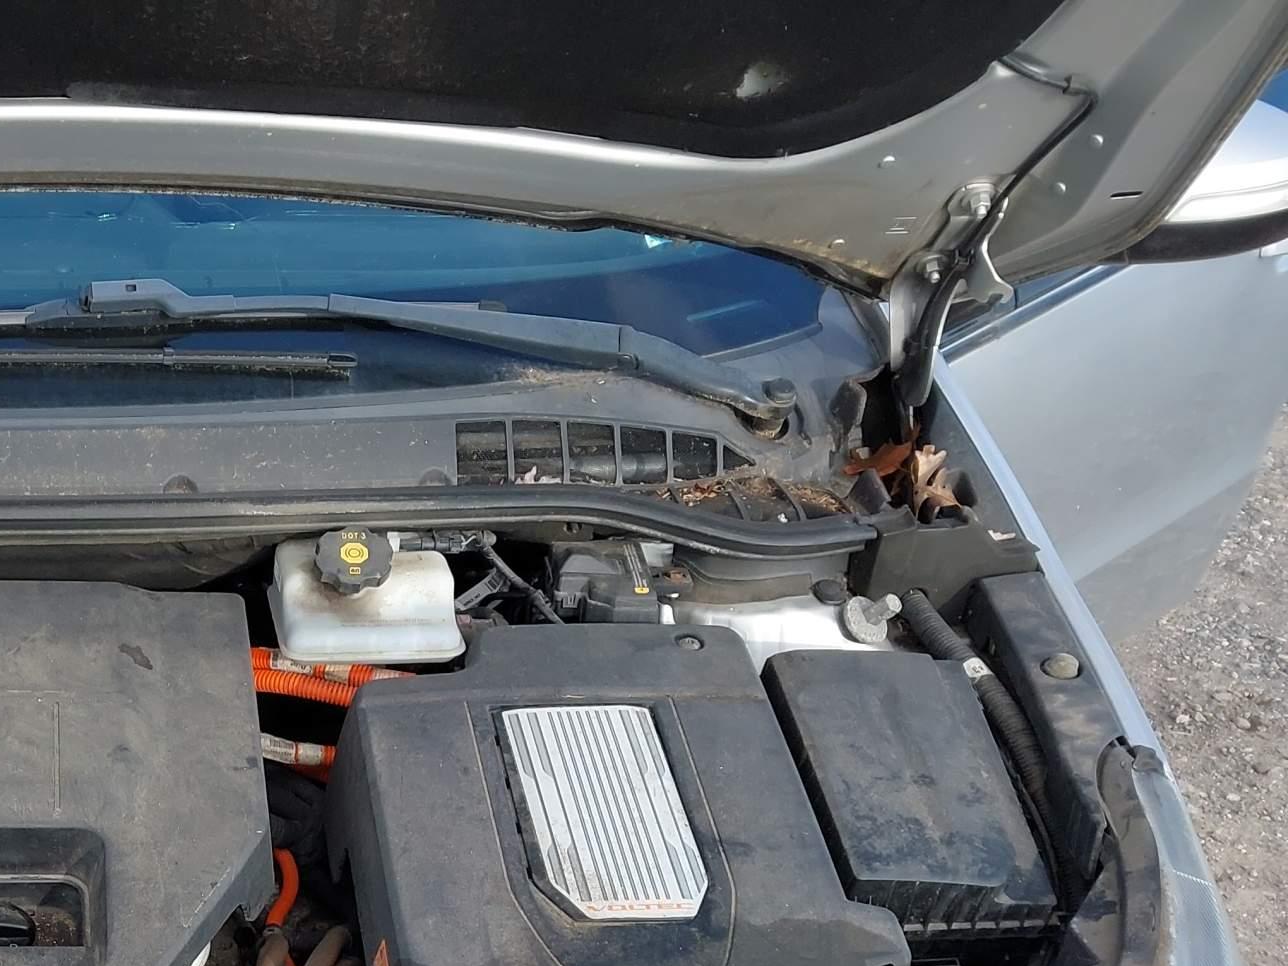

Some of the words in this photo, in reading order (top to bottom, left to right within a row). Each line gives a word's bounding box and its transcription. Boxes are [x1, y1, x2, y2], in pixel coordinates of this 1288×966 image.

[341, 532, 359, 540] DOT
[360, 532, 367, 540] 3
[586, 903, 696, 912] VOLTEC
